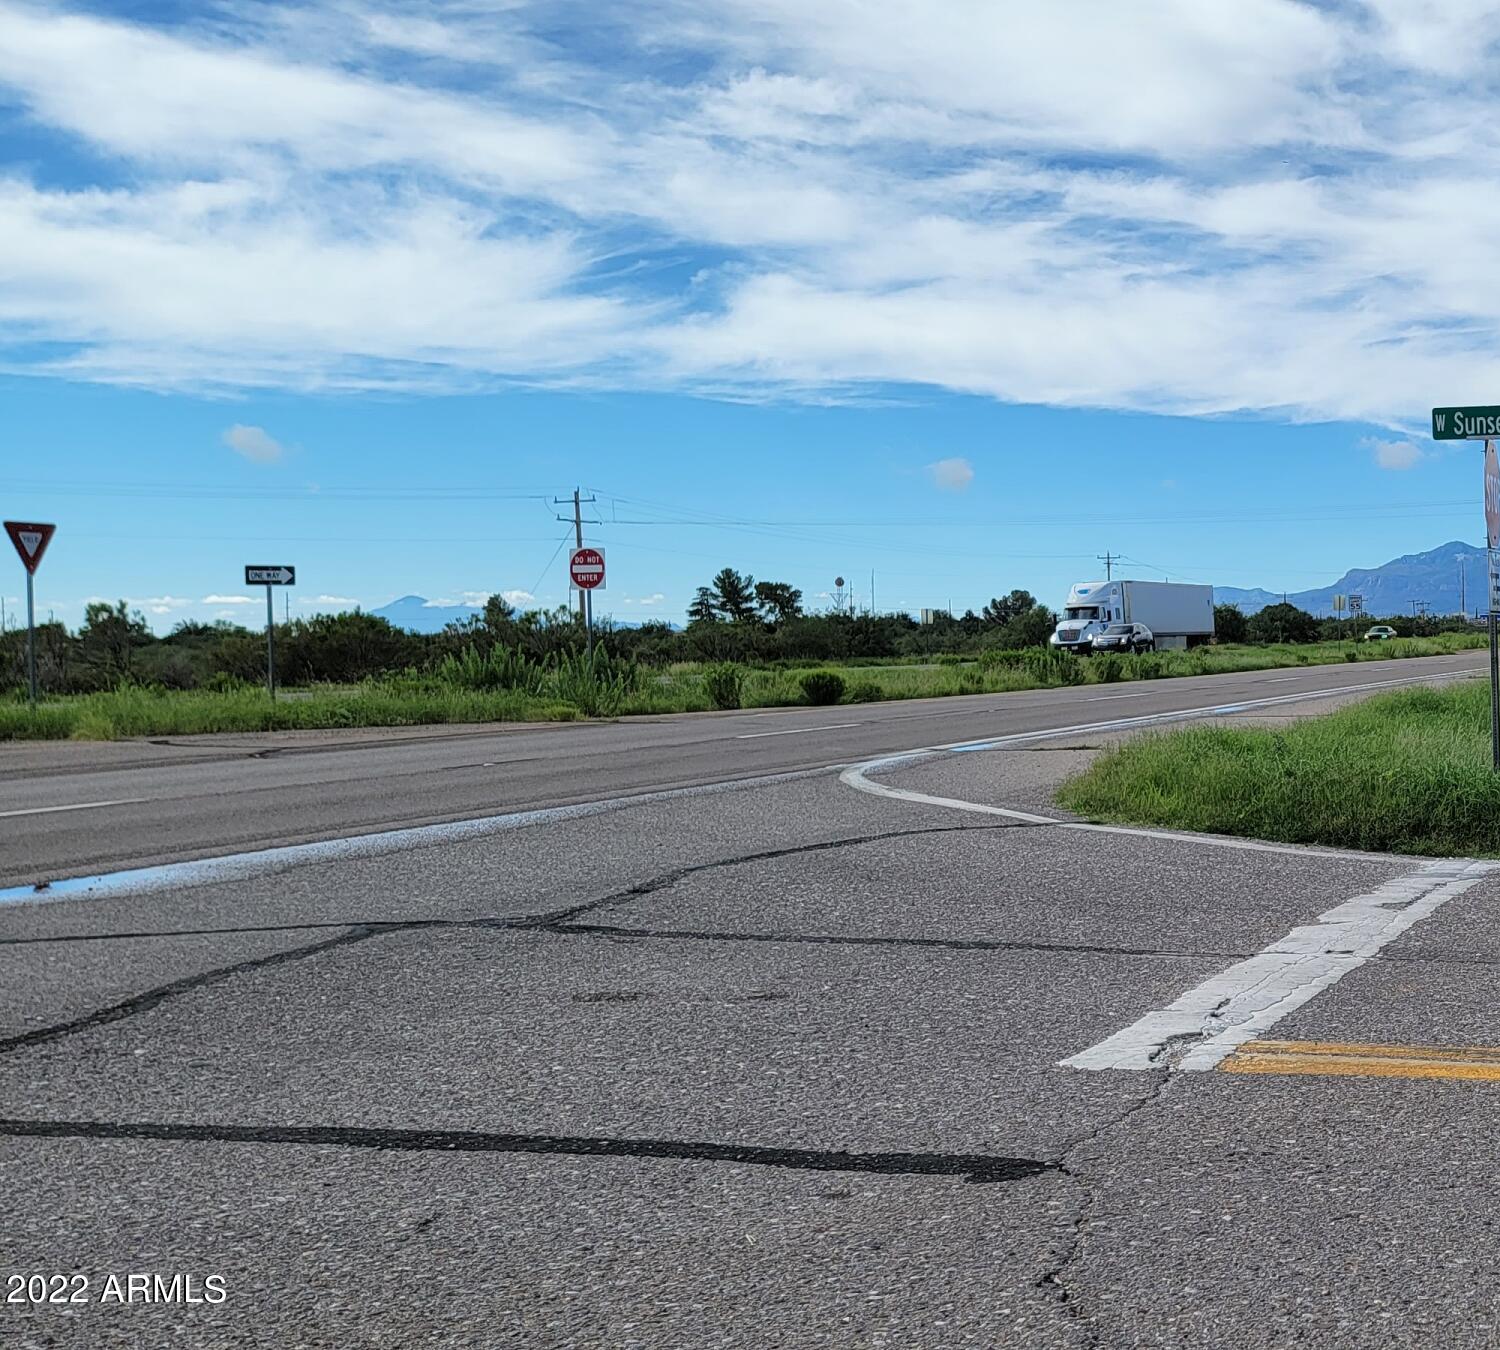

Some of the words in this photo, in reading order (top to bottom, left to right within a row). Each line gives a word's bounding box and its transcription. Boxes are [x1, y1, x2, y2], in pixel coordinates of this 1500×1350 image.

[1435, 413, 1446, 432] W
[1486, 473, 1500, 513] STOP
[574, 556, 584, 564] DO
[587, 556, 600, 564] NOT
[250, 571, 263, 580] ONE
[265, 571, 280, 580] WAY
[577, 574, 598, 582] ENTER
